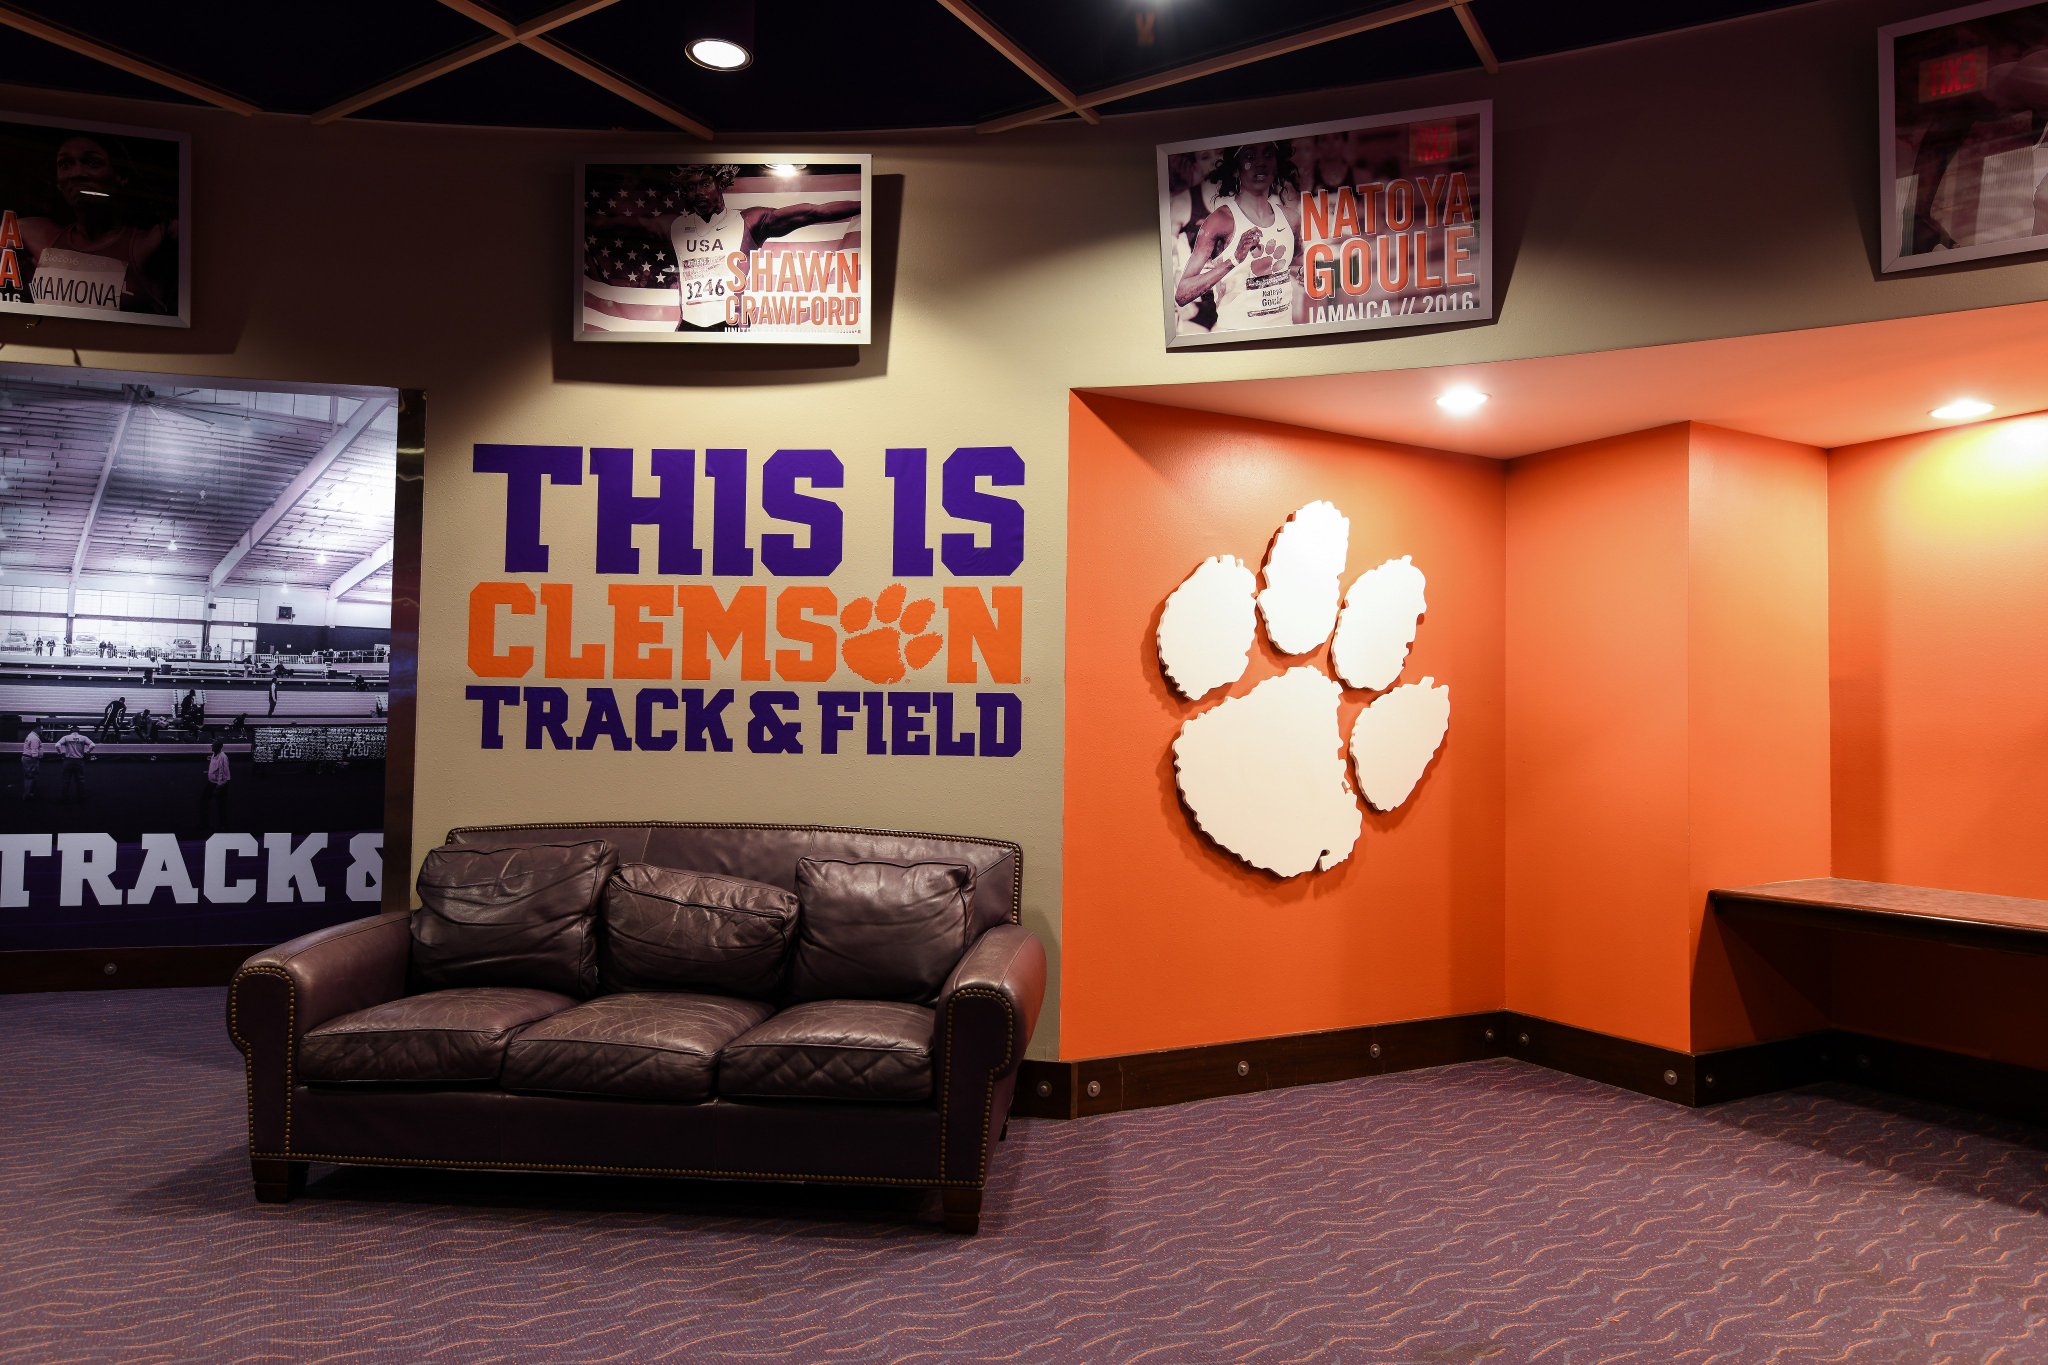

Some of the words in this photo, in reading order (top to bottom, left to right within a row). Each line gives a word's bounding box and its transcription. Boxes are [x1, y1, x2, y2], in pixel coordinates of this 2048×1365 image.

[1301, 172, 1475, 242] NATOYA
[686, 238, 724, 252] USA
[726, 250, 860, 294] SHAWN
[1304, 226, 1476, 300] GOULE
[33, 276, 117, 308] MAMONA
[686, 278, 725, 300] 3246
[725, 295, 860, 327] CRAWFORD
[1309, 299, 1392, 324] JAMAICA
[1422, 291, 1474, 313] 2016
[473, 443, 844, 577] THIS
[885, 446, 1025, 577] IS
[467, 581, 1022, 685] CLEMSN
[465, 685, 734, 752] TRACK
[747, 690, 803, 754] &
[817, 691, 1022, 757] FIELD
[0, 832, 328, 907] TRACK
